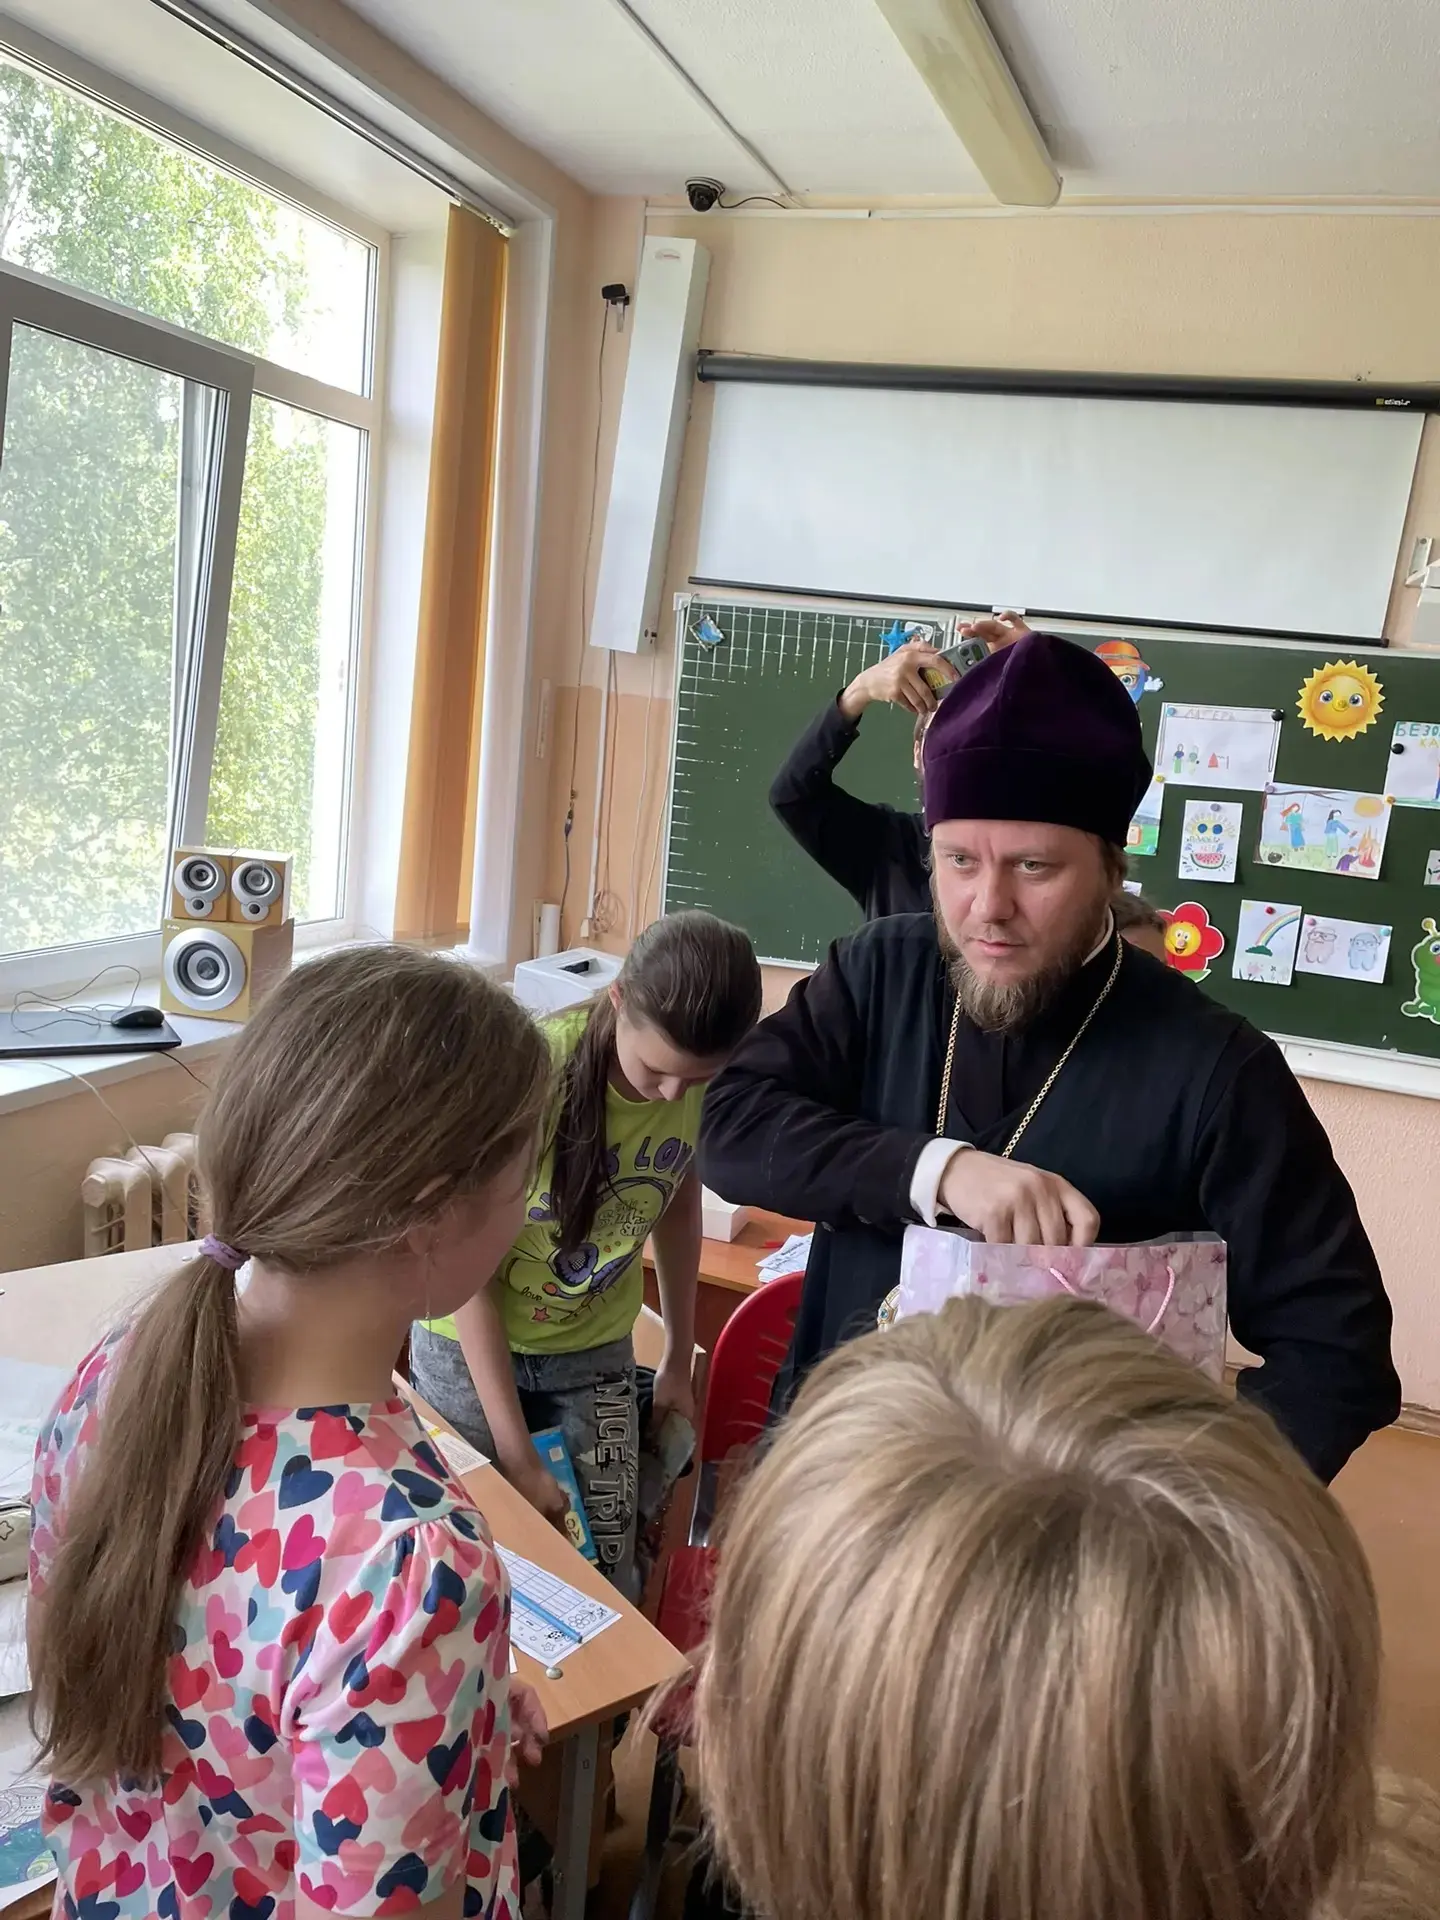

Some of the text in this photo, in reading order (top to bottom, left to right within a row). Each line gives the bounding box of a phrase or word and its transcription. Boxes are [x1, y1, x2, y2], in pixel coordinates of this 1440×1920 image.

[1395, 722, 1440, 737] БЕЗО
[594, 1379, 632, 1463] NICE
[584, 1472, 628, 1564] TRIP
